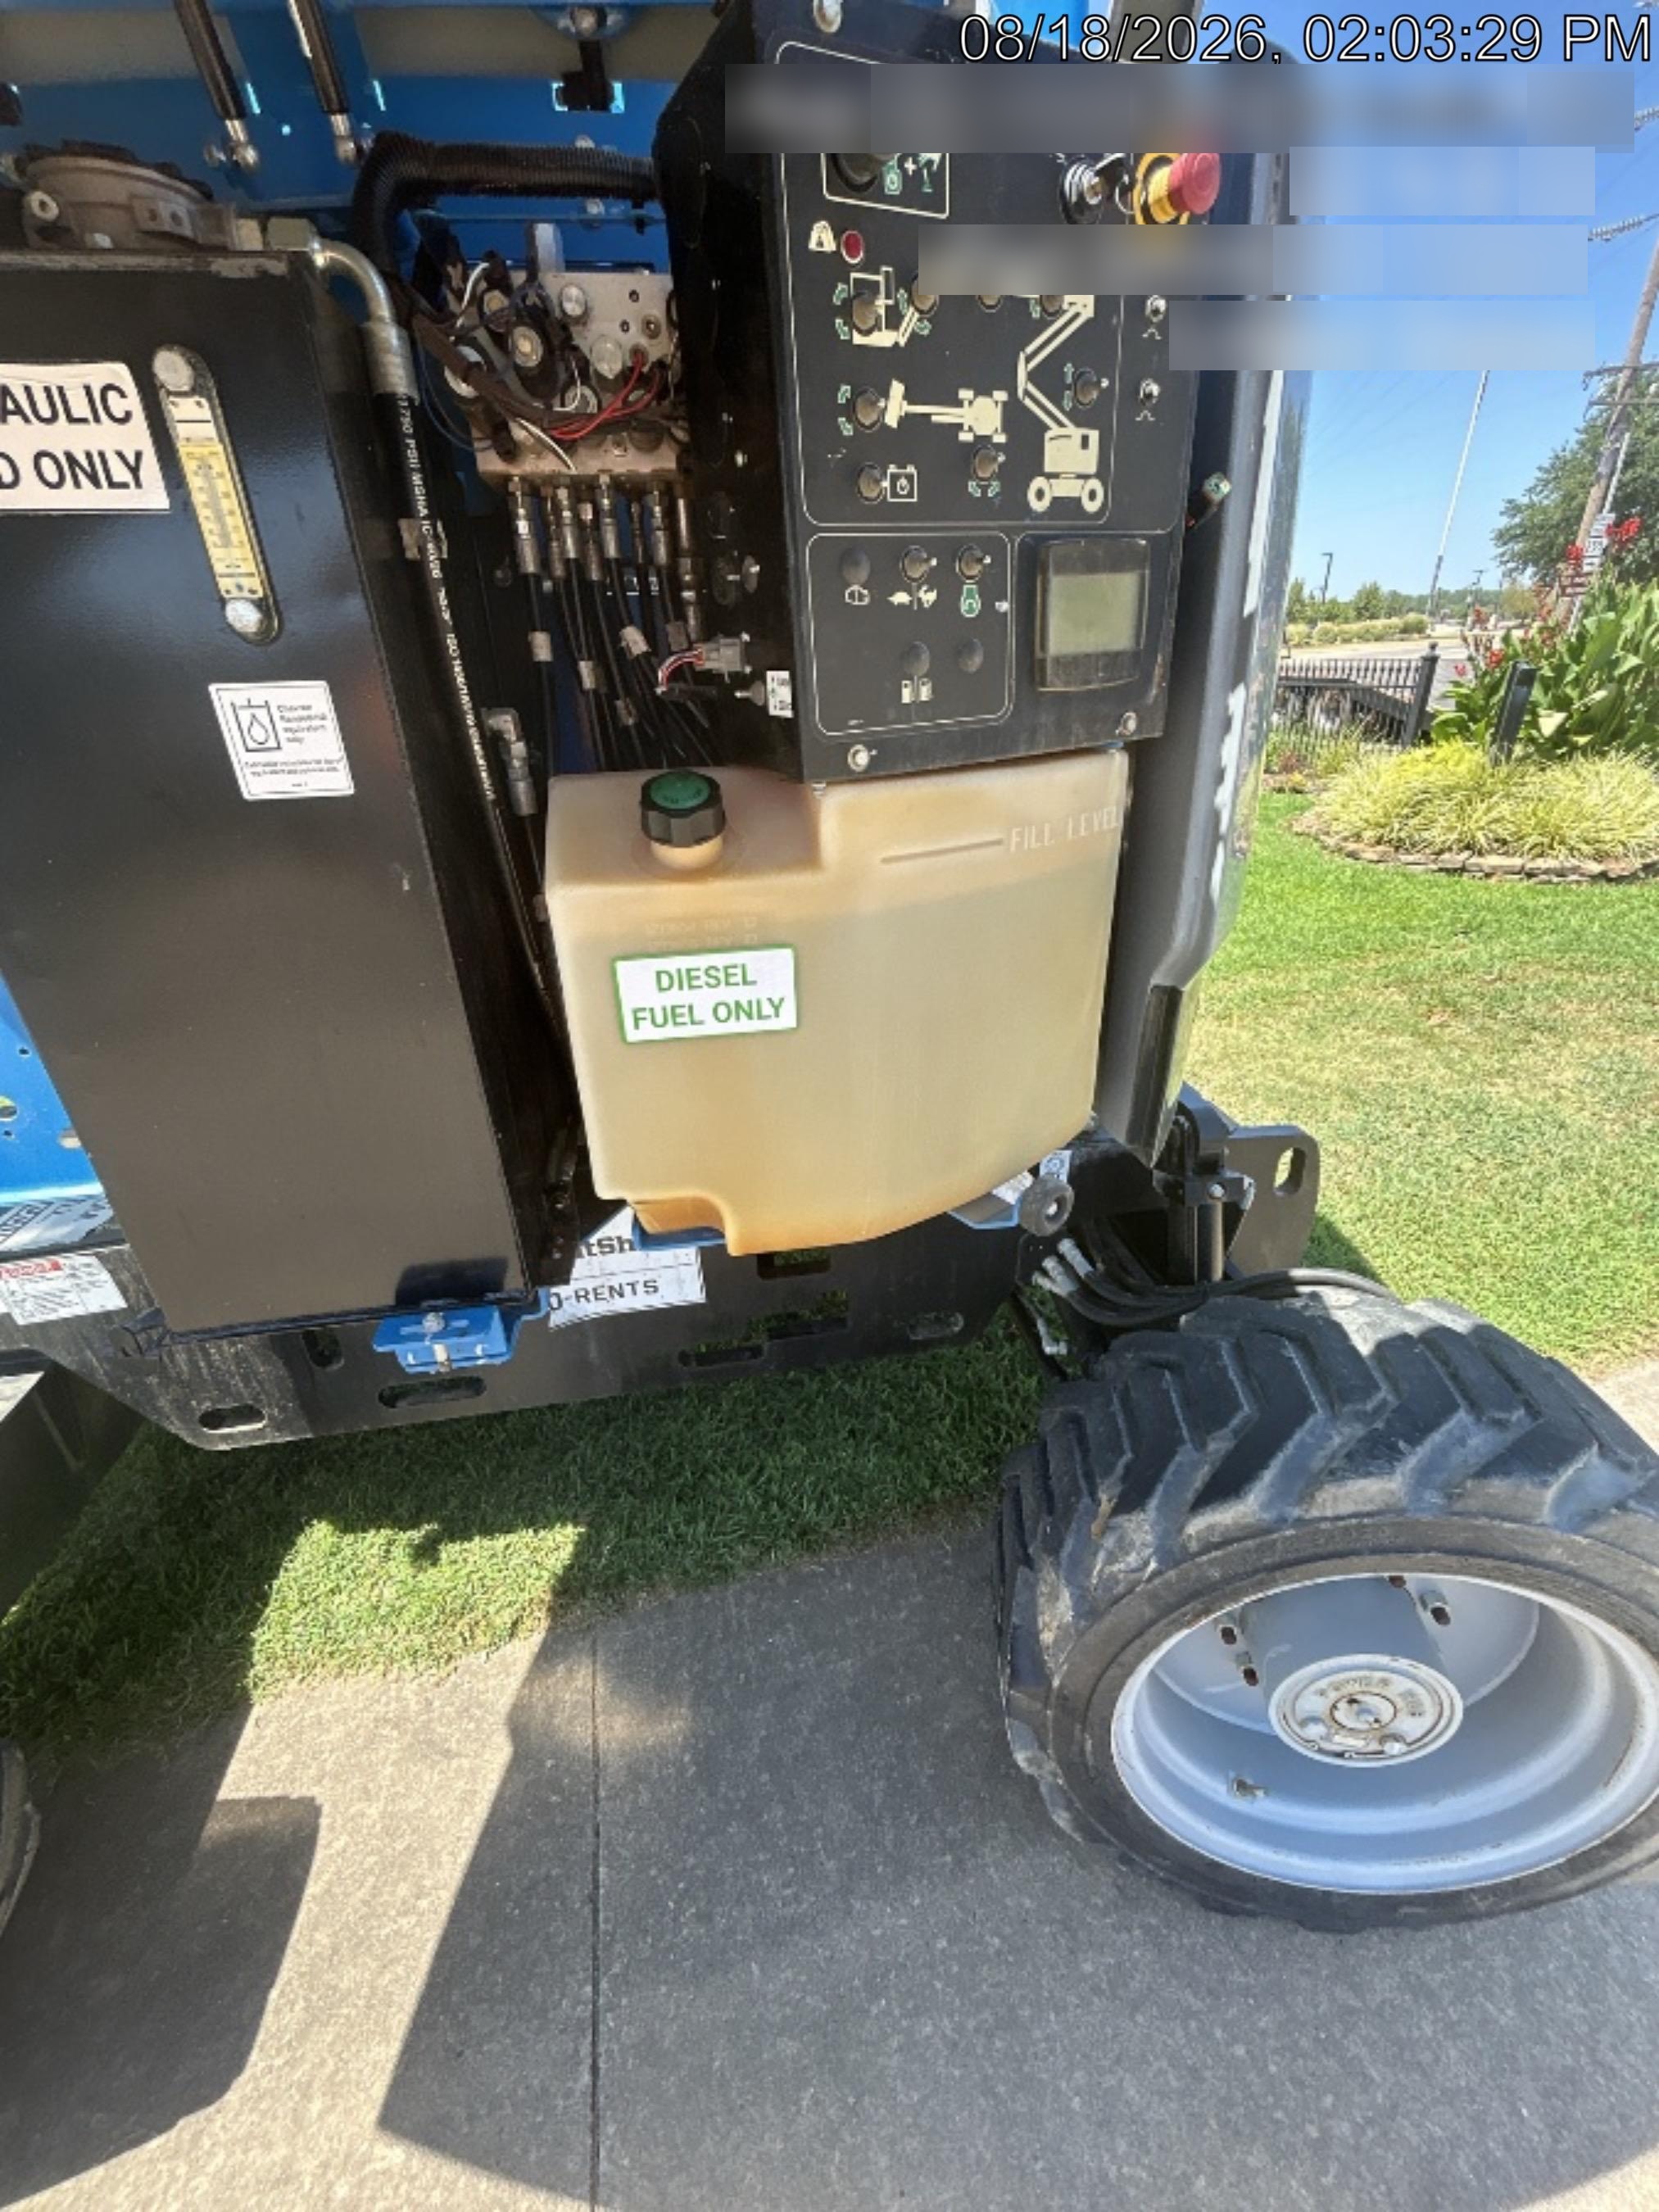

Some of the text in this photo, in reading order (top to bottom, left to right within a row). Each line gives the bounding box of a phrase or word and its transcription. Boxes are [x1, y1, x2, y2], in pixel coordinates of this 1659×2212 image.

[34, 450, 143, 490] ONLY
[1010, 806, 1122, 854] FILL LEVEL
[656, 963, 757, 993] DIESEL
[631, 997, 785, 1031] FUEL ONLY
